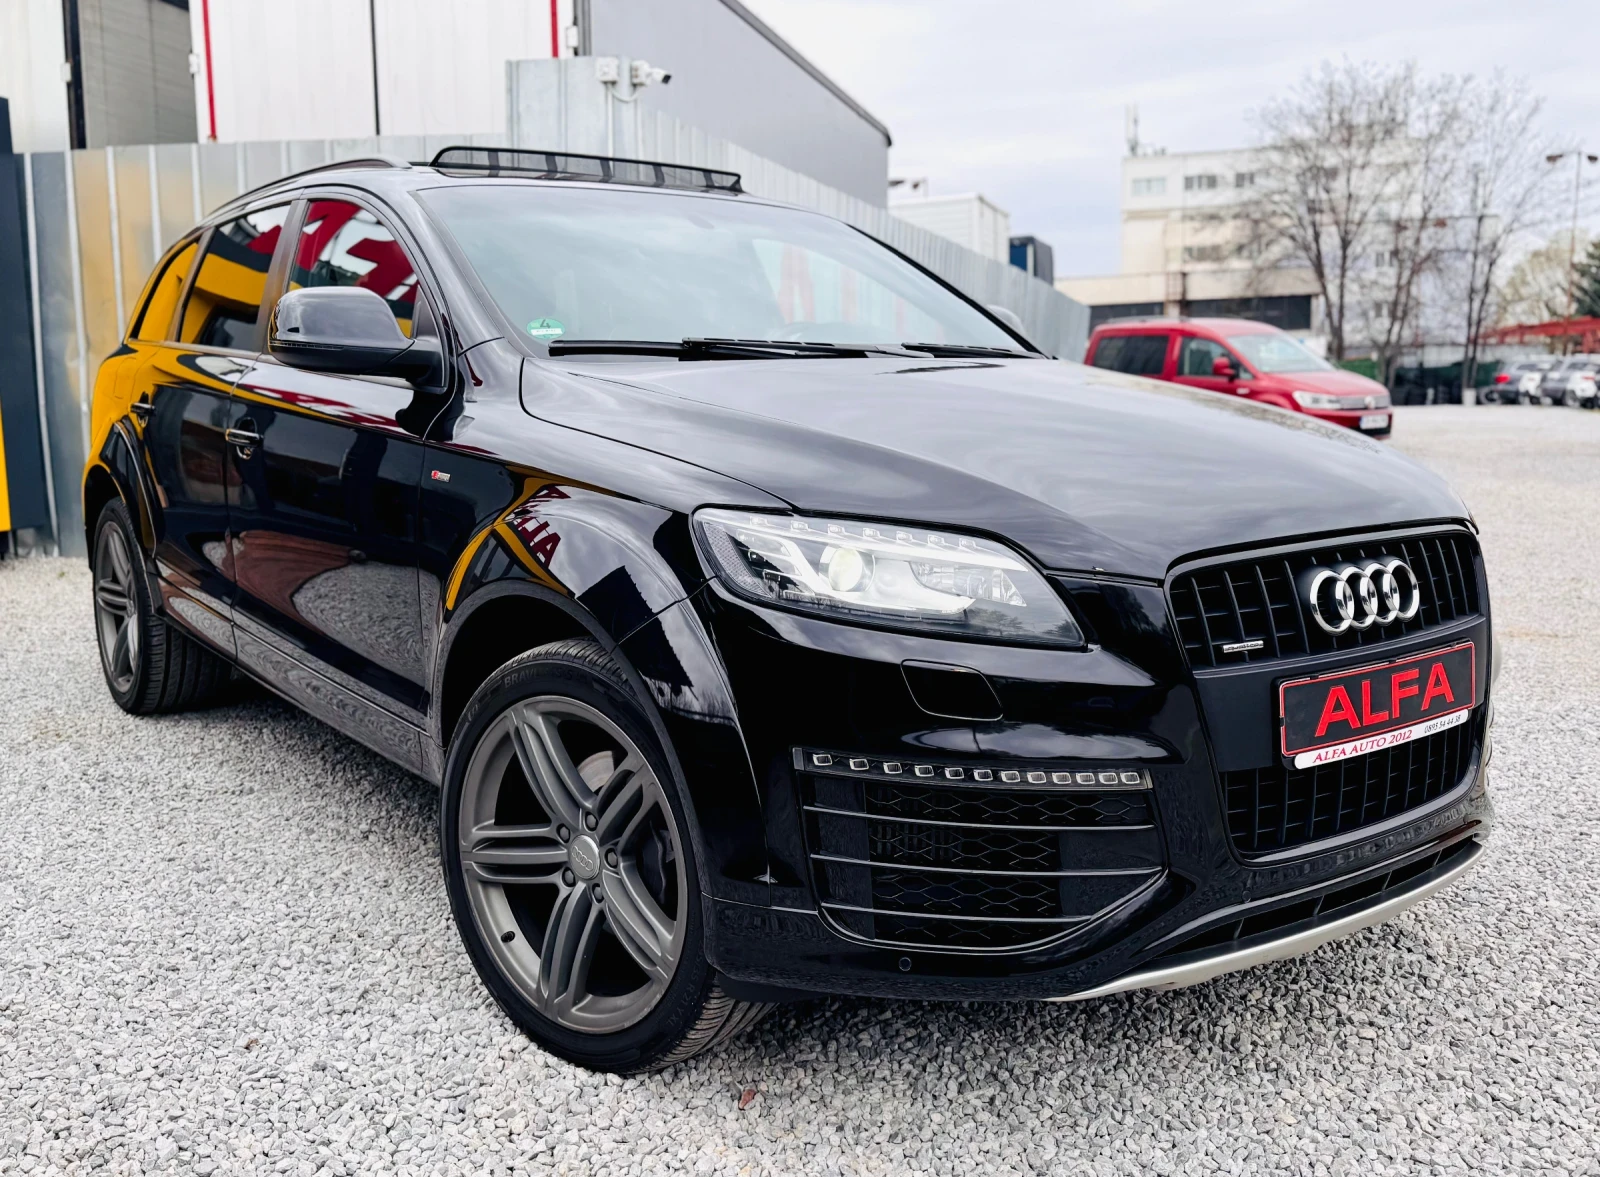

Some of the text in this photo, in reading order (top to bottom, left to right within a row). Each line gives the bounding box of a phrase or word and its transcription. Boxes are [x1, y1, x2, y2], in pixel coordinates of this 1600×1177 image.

[540, 319, 551, 328] 4
[1314, 662, 1454, 737] ALFA
[1313, 729, 1413, 763] ALFA AUTO 2012
